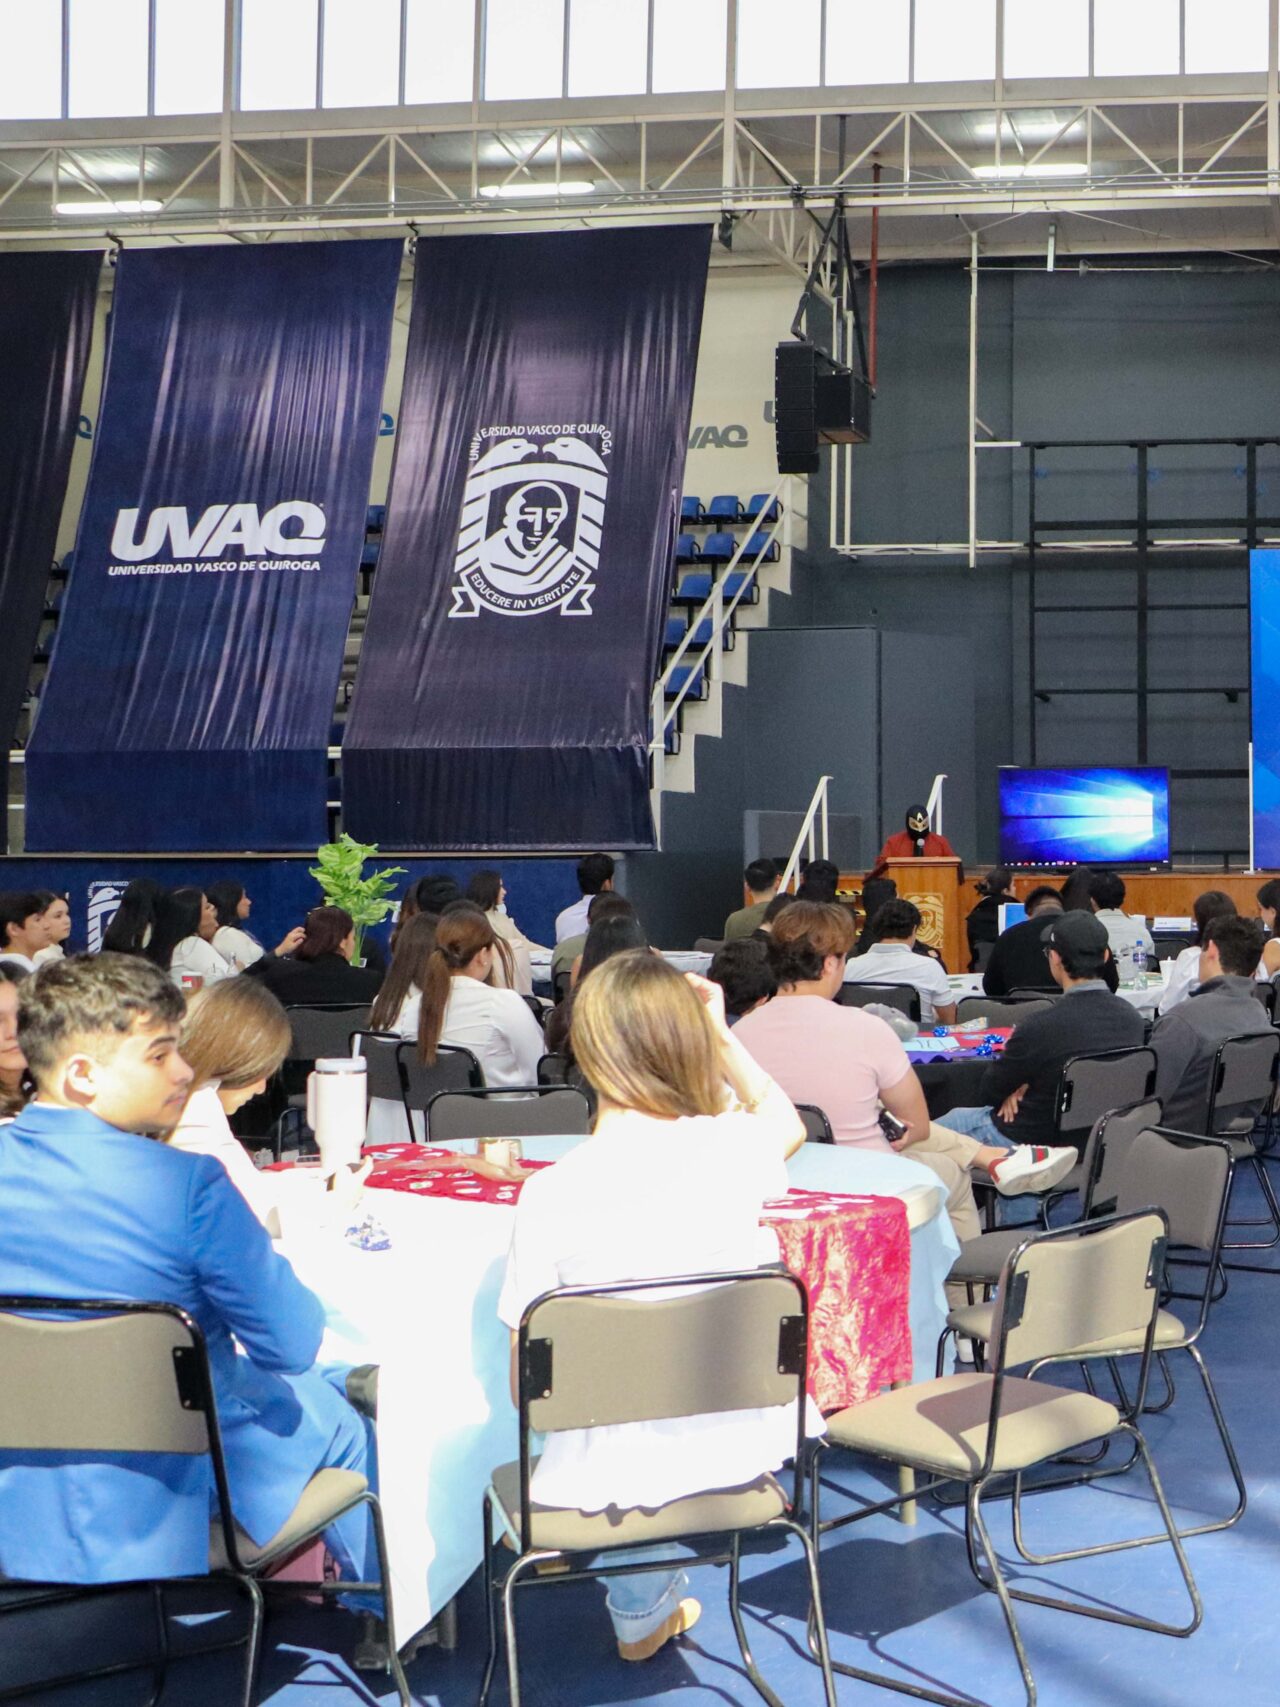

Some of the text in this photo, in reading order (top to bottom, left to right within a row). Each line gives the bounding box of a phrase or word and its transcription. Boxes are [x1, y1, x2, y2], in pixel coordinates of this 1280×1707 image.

[469, 423, 612, 461] UNIVERSIDAD VASCO DE QUIROGA
[110, 500, 326, 561] UVAQ
[108, 560, 321, 576] UNIVERSIDAD VASCO DE QUIROGA
[470, 571, 580, 609] EDUCERE IN VERITATE
